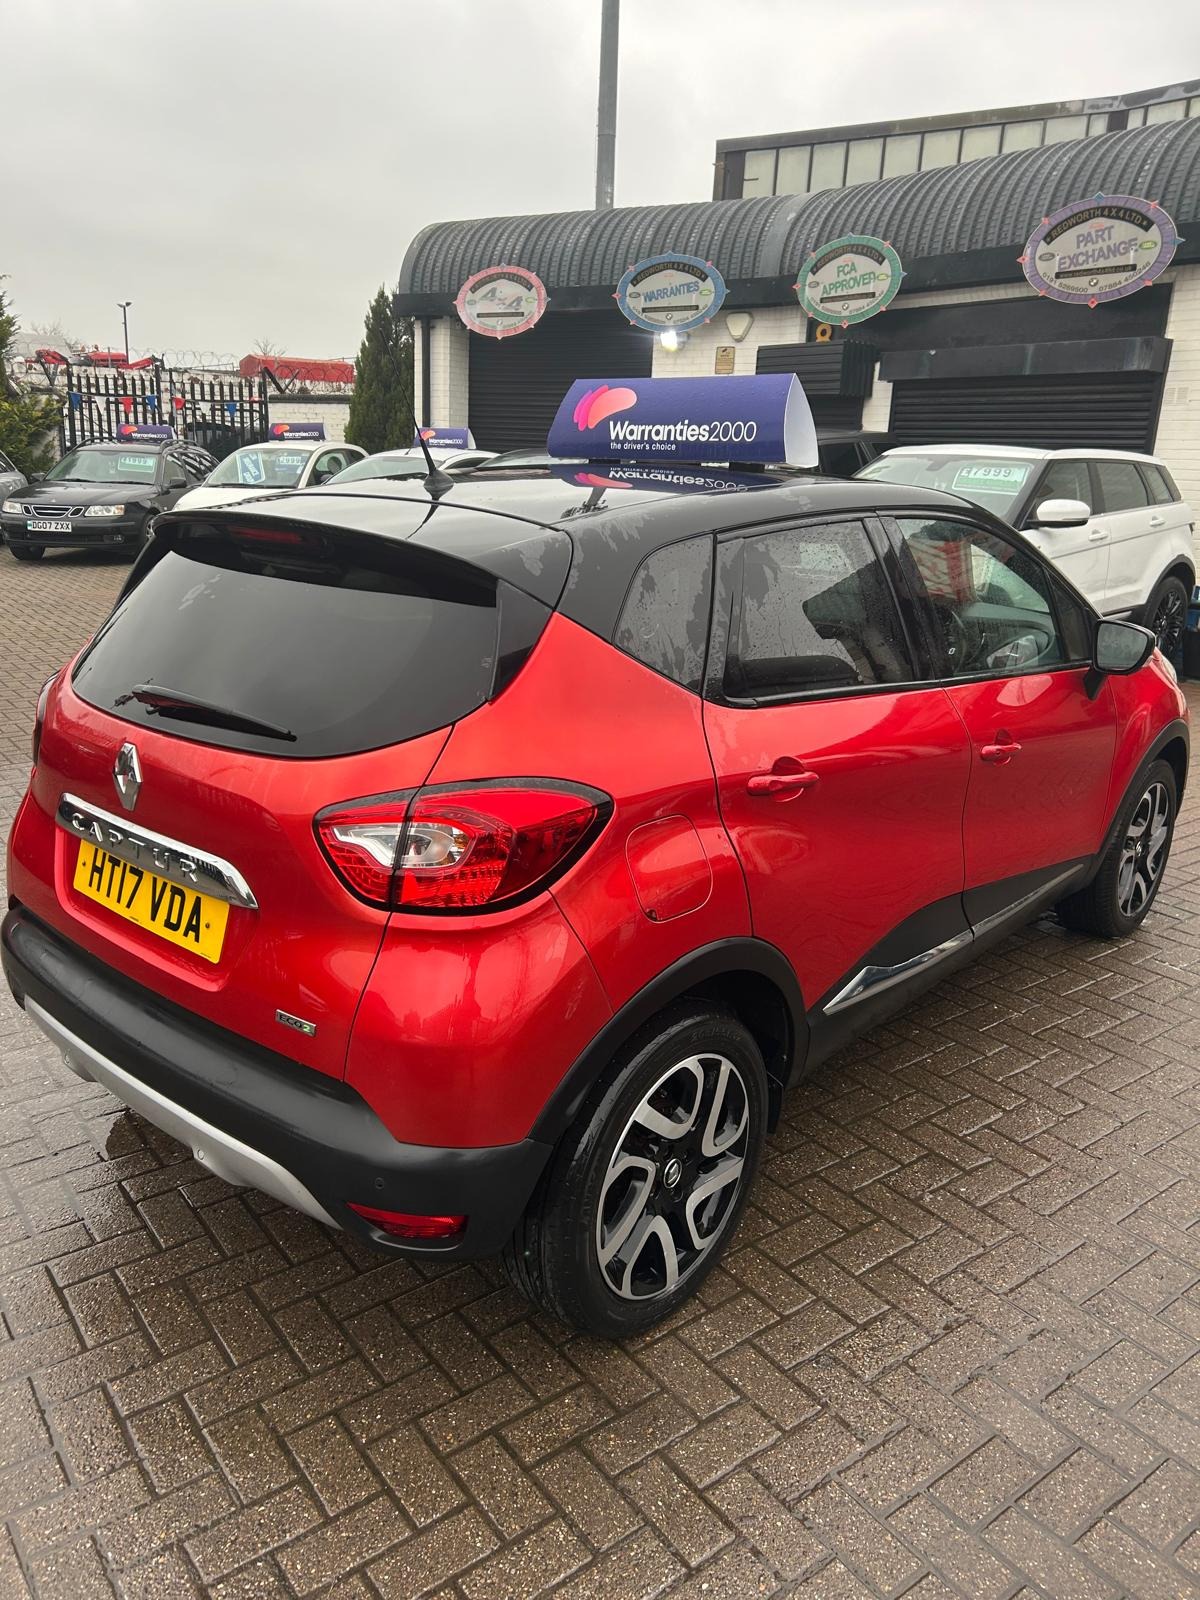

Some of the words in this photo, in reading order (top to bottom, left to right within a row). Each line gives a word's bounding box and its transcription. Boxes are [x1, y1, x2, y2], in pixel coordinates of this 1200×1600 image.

[1051, 208, 1100, 238] REDWORTH
[1102, 207, 1109, 218] 4
[1126, 210, 1143, 224] LTD
[1076, 225, 1114, 249] PART
[1057, 238, 1138, 271] EXCHANGE
[836, 262, 857, 277] FCA
[643, 281, 700, 303] WARRANTIES
[821, 271, 876, 296] APPROVED
[609, 419, 757, 442] Warranties2000
[610, 442, 621, 450] the
[624, 442, 650, 450] driver's
[652, 443, 676, 451] choice
[33, 521, 52, 530] DG07
[54, 522, 71, 530] ZXX
[72, 812, 199, 883] CAPTUR
[88, 847, 144, 909] HT17
[150, 876, 201, 943] VDA
